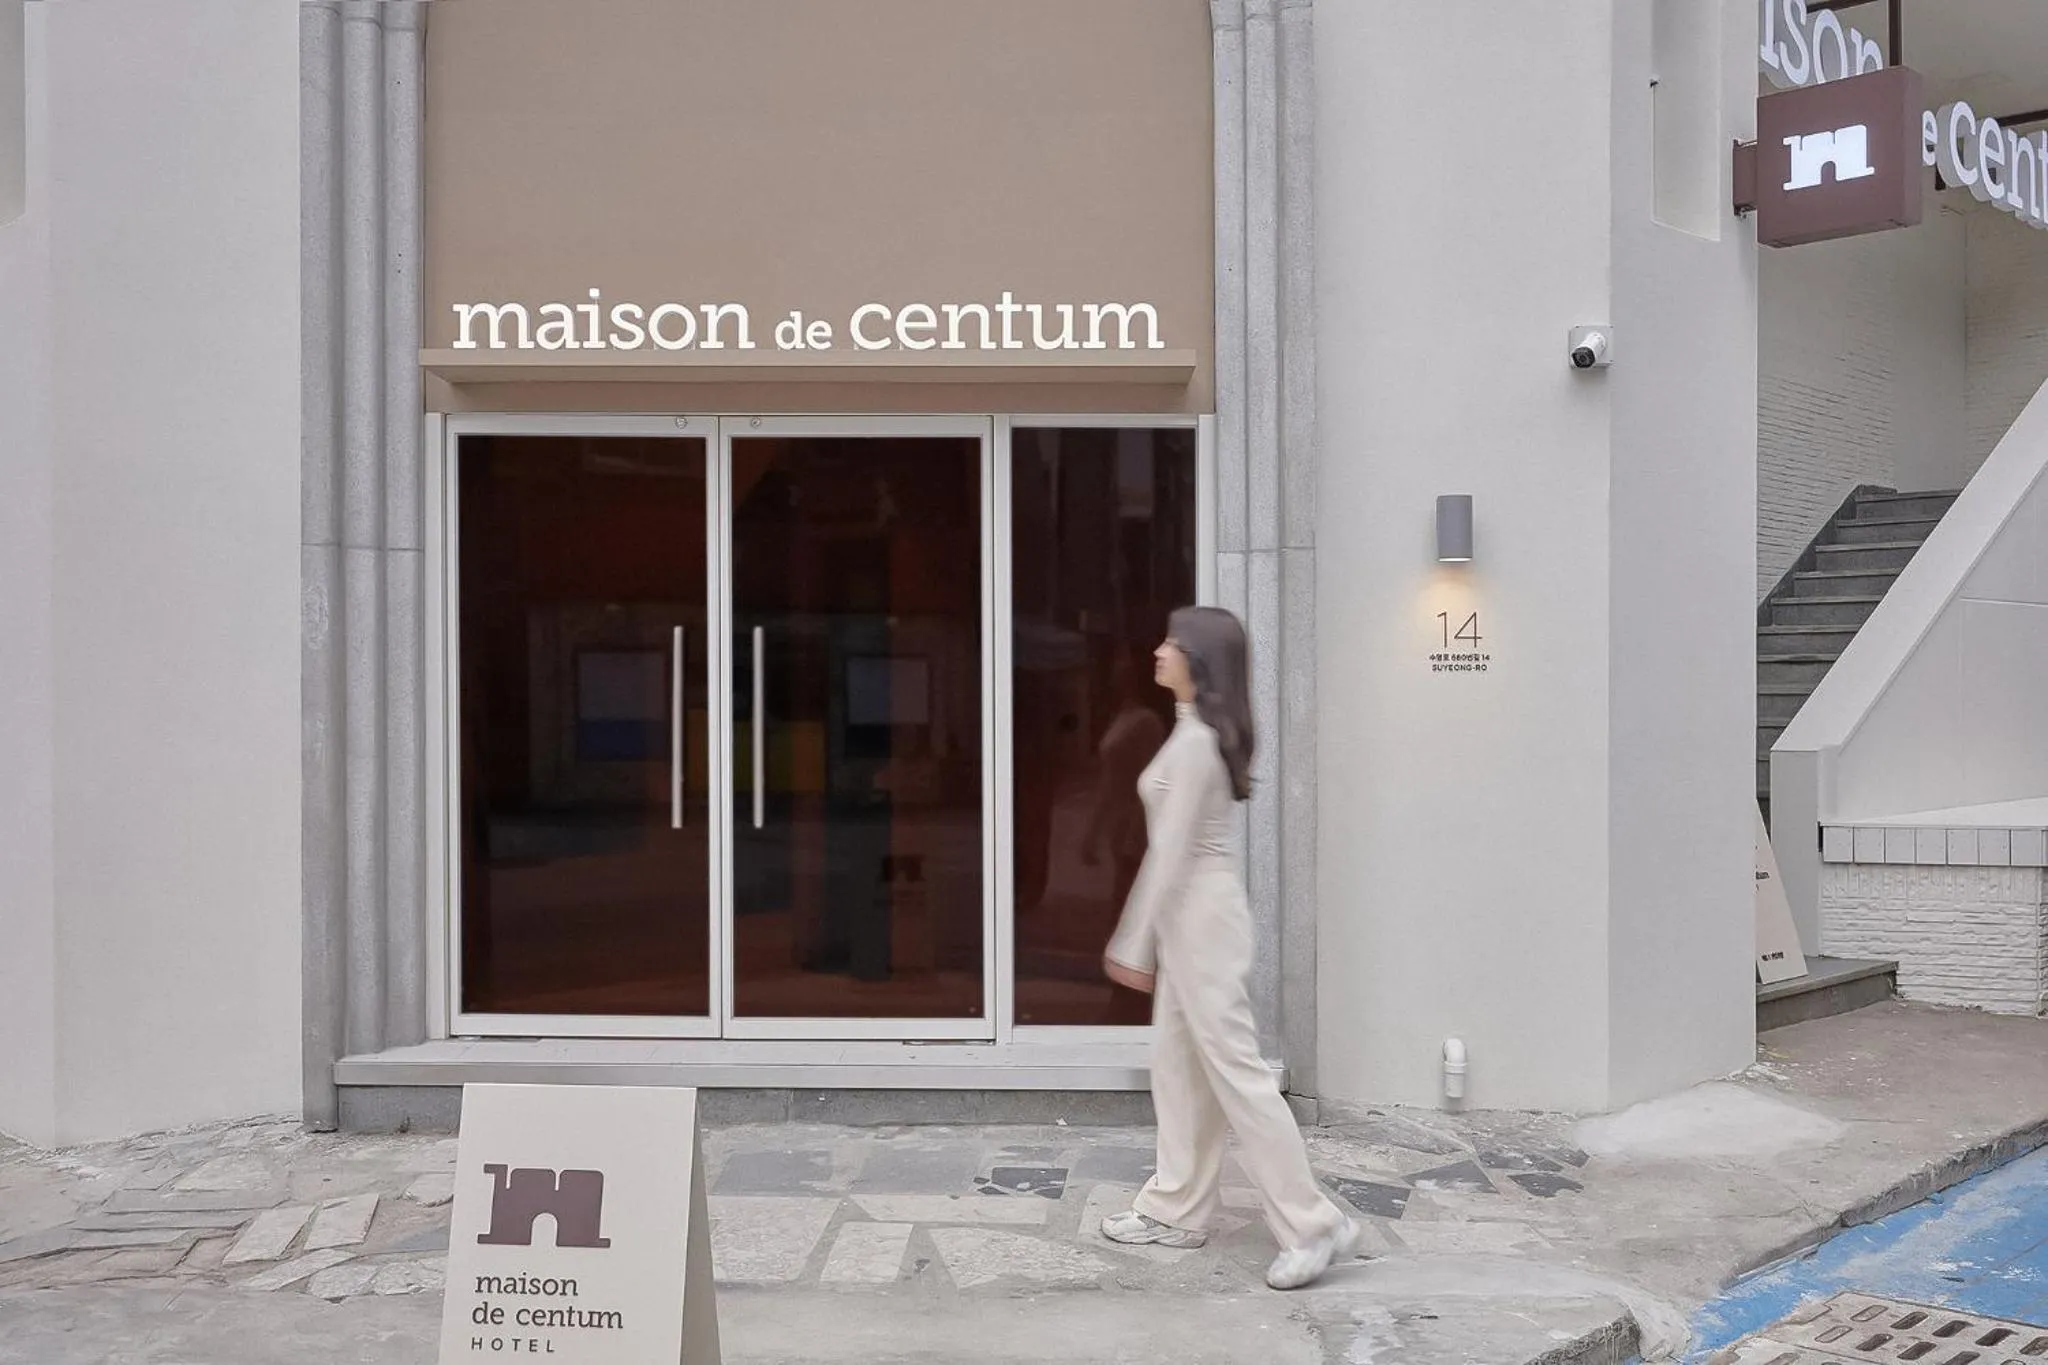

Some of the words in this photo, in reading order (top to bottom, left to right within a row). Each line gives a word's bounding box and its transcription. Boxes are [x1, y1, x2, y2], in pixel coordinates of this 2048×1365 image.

[453, 288, 755, 349] maison
[775, 312, 832, 349] de
[850, 292, 1164, 350] centum
[1437, 611, 1483, 648] 14
[1432, 664, 1488, 672] SUYEONG-RO
[474, 1272, 579, 1297] maison
[472, 1302, 505, 1325] de
[515, 1306, 624, 1330] centum
[471, 1336, 555, 1353] HOTEL
